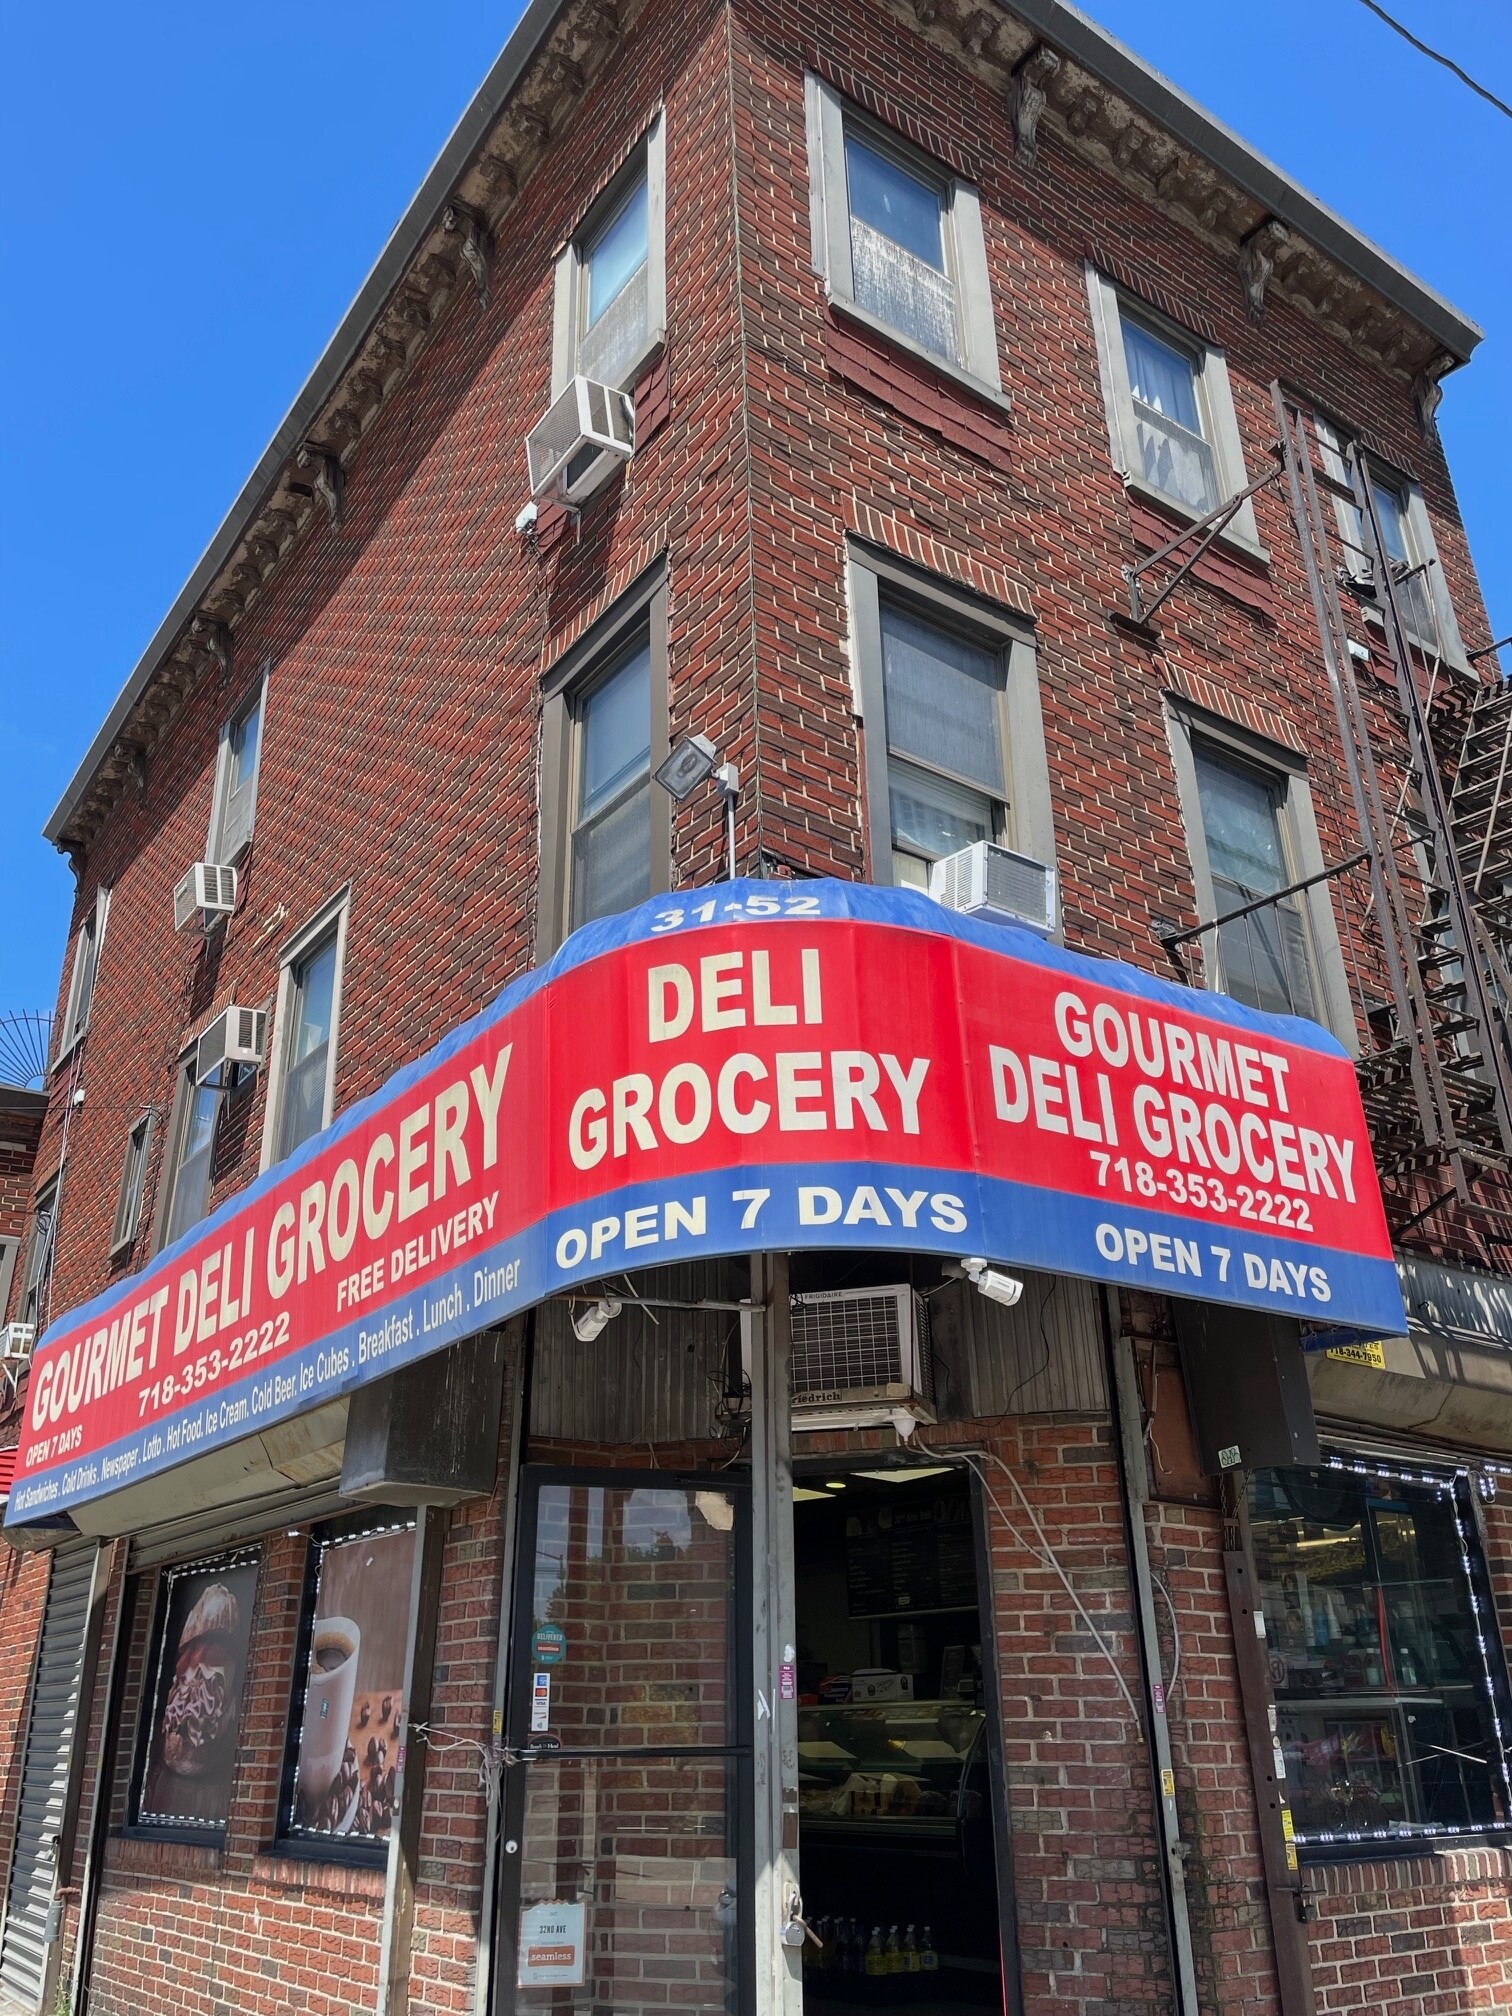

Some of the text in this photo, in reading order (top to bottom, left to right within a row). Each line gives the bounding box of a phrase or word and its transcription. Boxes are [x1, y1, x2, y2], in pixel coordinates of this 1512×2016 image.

[650, 895, 821, 932] 31-52
[648, 948, 823, 1043] DELI
[1054, 991, 1289, 1114] GOURMET
[568, 1050, 930, 1170] GROCERY
[988, 1044, 1357, 1204] DELI GROCERY
[555, 1186, 968, 1268] OPEN 7 DAYS
[1090, 1150, 1313, 1232] 718-353-2222
[32, 1042, 513, 1431] GOURMET DELI GROCERY
[337, 1191, 499, 1313] FREE DELIVERY
[1095, 1223, 1331, 1303] OPEN 7 DAYS
[804, 1291, 842, 1299] FRIGIDAIRE
[14, 1490, 26, 1512] Hot
[25, 1481, 59, 1508] Sandwiches
[62, 1469, 78, 1495] Cold
[77, 1463, 98, 1490] Drinks
[101, 1447, 139, 1481] Newspaper
[143, 1435, 161, 1462] Lotto
[167, 1423, 181, 1452] Hot
[205, 1409, 217, 1436] Ice
[251, 1379, 272, 1414] Cold
[300, 1362, 313, 1391] Ice
[317, 1347, 349, 1383] Cubes
[358, 1307, 414, 1365] Breakfast
[423, 1283, 462, 1332] Lunch
[474, 1258, 521, 1308] Dinner
[138, 1311, 290, 1417] 718-353-2222
[791, 1392, 840, 1403] riedrich
[26, 1425, 83, 1468] OPEN 7 DAYS
[531, 1951, 572, 1961] seamless
[539, 1925, 567, 1934] 32ND AVE
